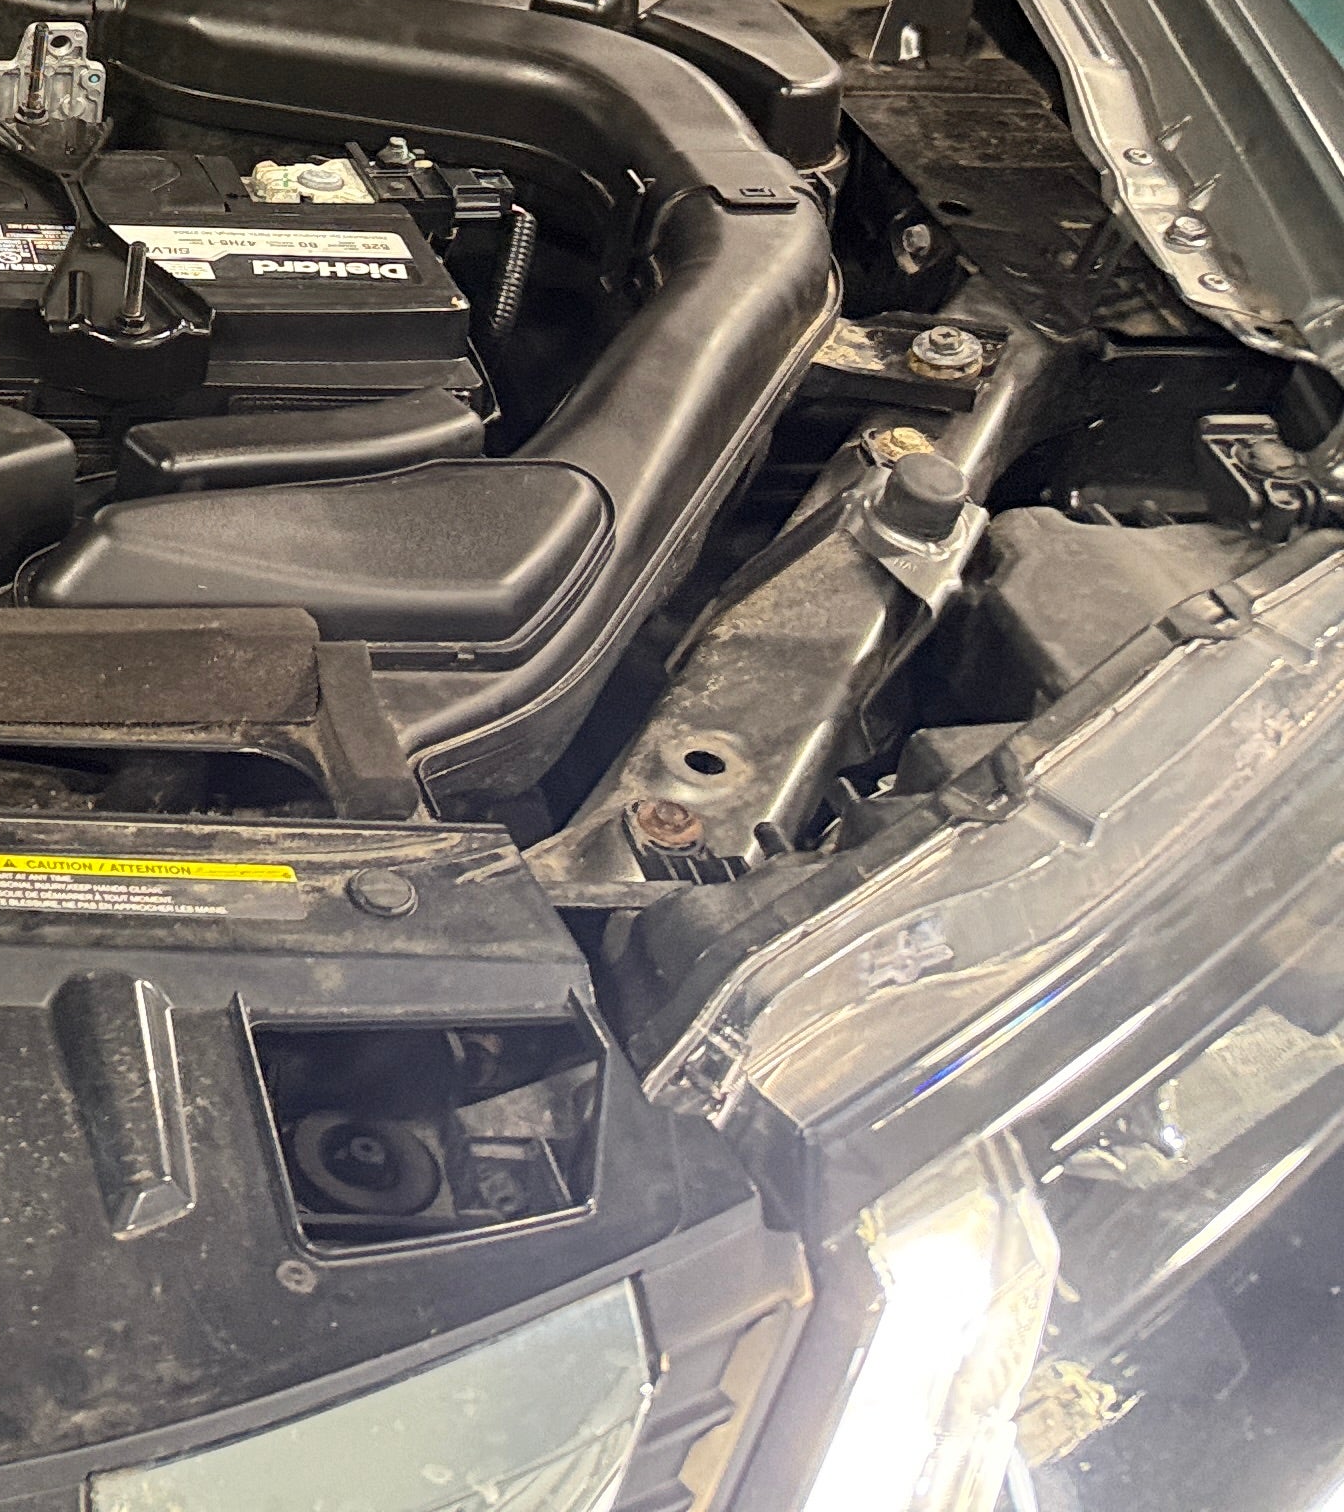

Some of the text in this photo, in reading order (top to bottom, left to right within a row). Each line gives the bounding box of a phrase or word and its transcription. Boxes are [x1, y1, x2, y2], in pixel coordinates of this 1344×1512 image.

[145, 247, 190, 255] SILV
[252, 259, 409, 280] DieHard
[25, 859, 192, 876] CAUTION / ATTENTION
